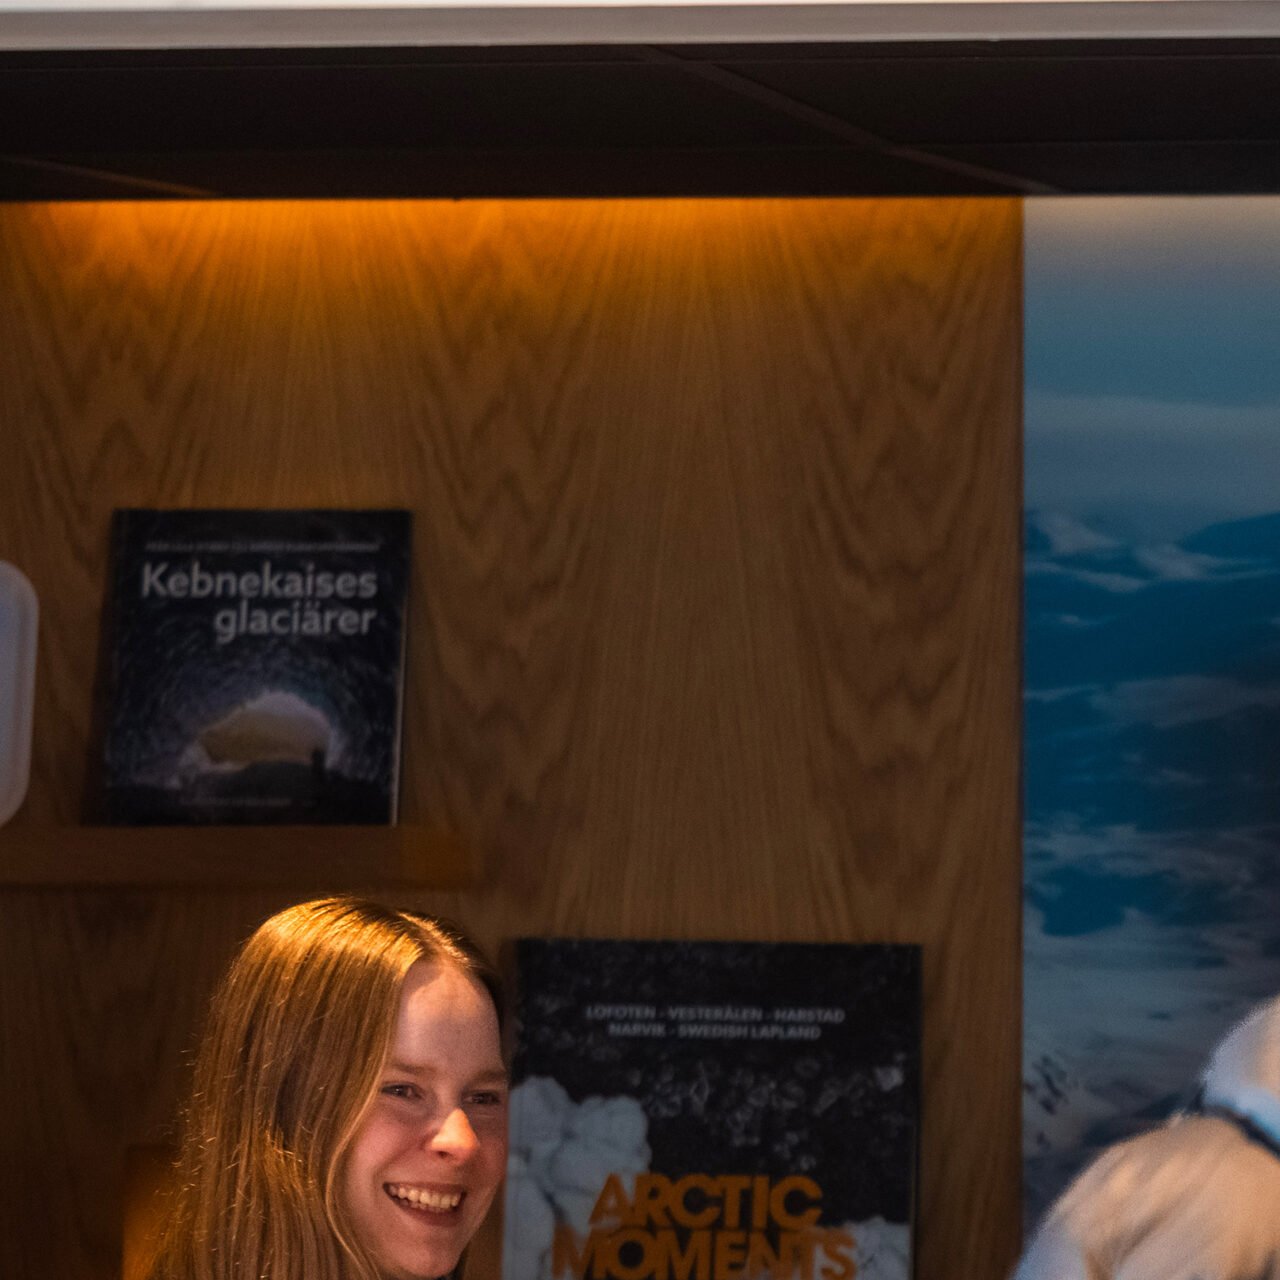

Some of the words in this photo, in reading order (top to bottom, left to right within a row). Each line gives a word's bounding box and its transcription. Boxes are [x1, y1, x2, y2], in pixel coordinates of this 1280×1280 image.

[142, 561, 378, 598] Kebnekaises
[214, 599, 378, 645] glaciärer
[585, 1005, 657, 1020] LOFOTEN
[774, 1007, 846, 1024] HARSTAD
[608, 1023, 666, 1037] NARVIK
[678, 1024, 748, 1039] SWEDISH
[751, 1025, 822, 1040] LAPLAND
[588, 1172, 823, 1230] ARCTIC
